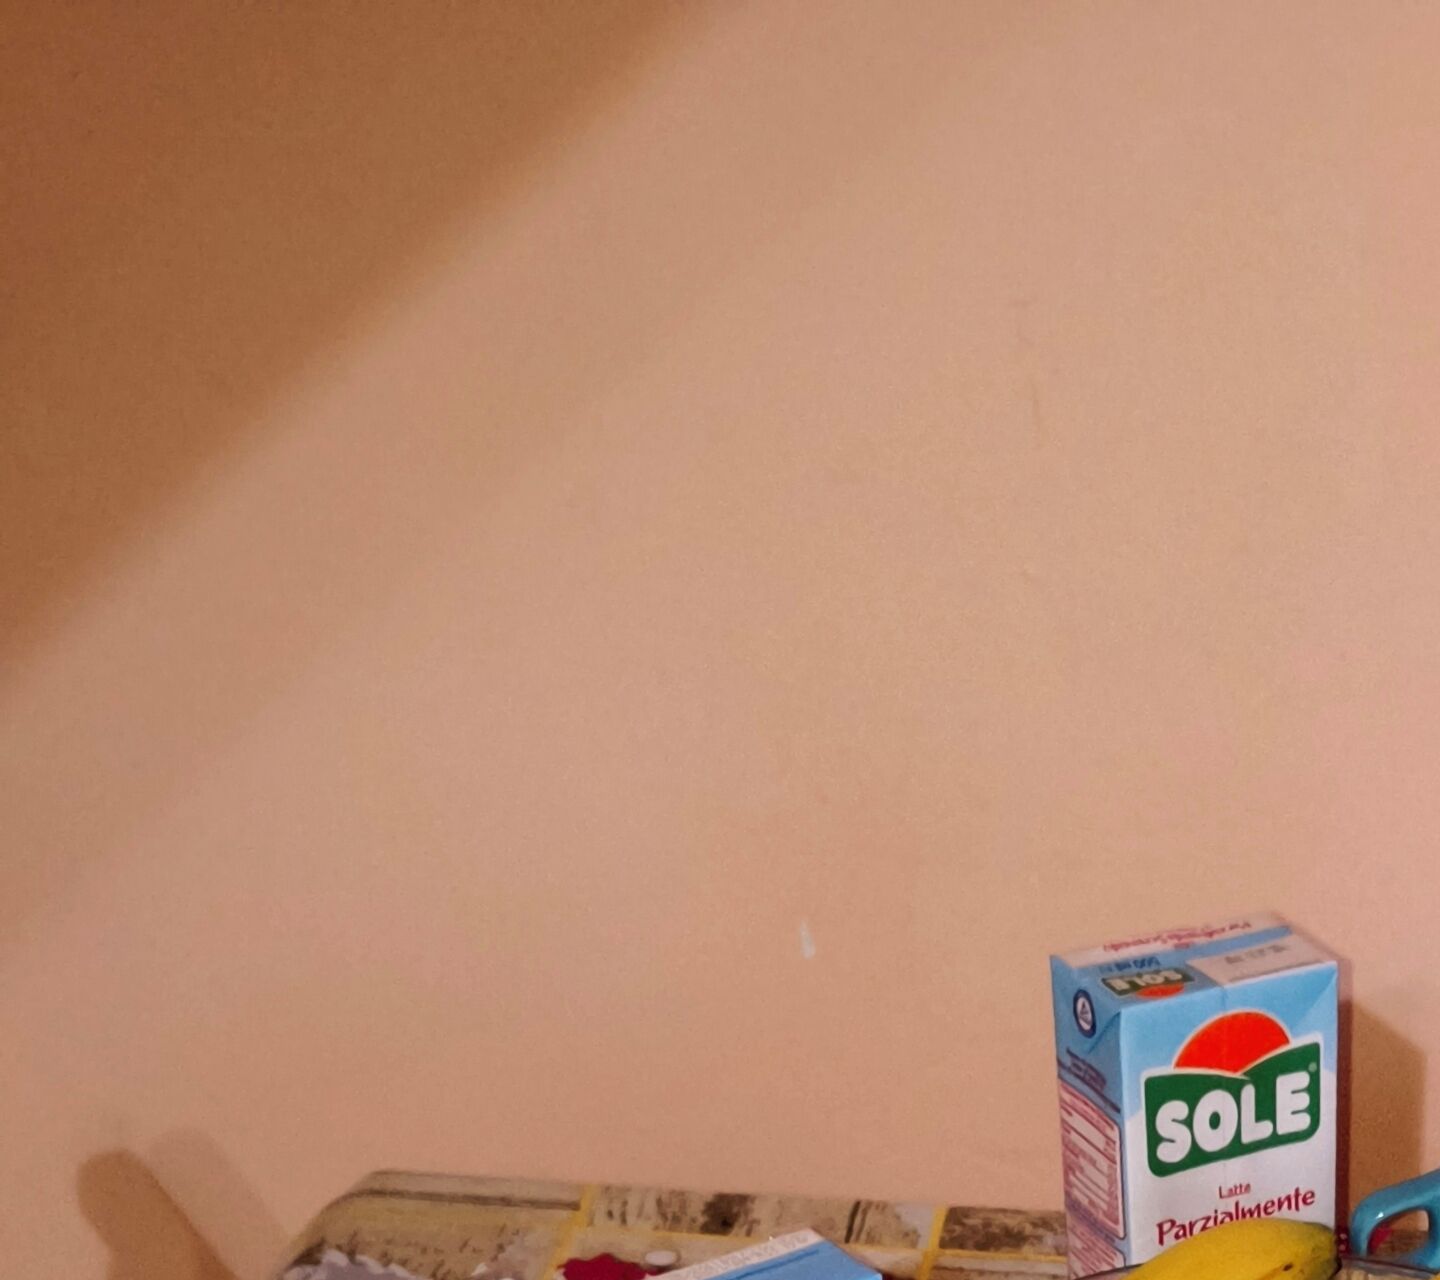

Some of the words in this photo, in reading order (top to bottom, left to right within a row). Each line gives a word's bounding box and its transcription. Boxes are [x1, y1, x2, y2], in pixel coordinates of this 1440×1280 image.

[1154, 1070, 1312, 1164] SOLE
[1156, 1186, 1316, 1247] Parzialmente
[1218, 1182, 1252, 1199] Latte
